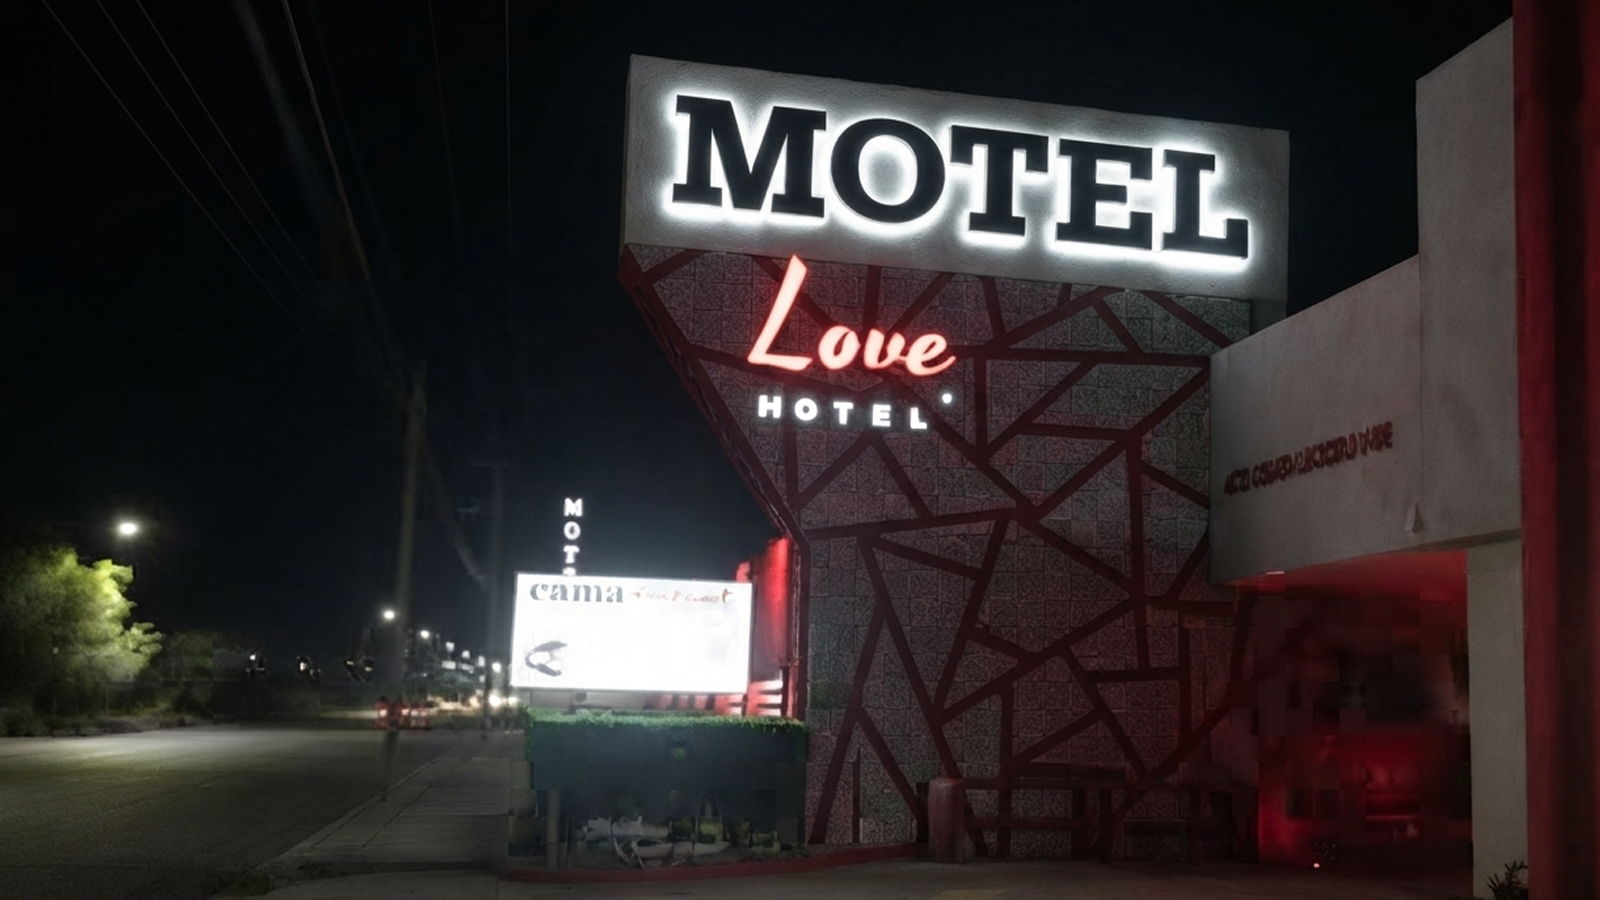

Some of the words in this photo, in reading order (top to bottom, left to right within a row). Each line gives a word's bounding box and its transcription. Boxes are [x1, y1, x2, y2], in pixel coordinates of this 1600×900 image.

[672, 95, 1249, 258] MOTEL
[747, 254, 957, 376] Love
[757, 394, 928, 430] HOTEL
[529, 583, 624, 604] cama
